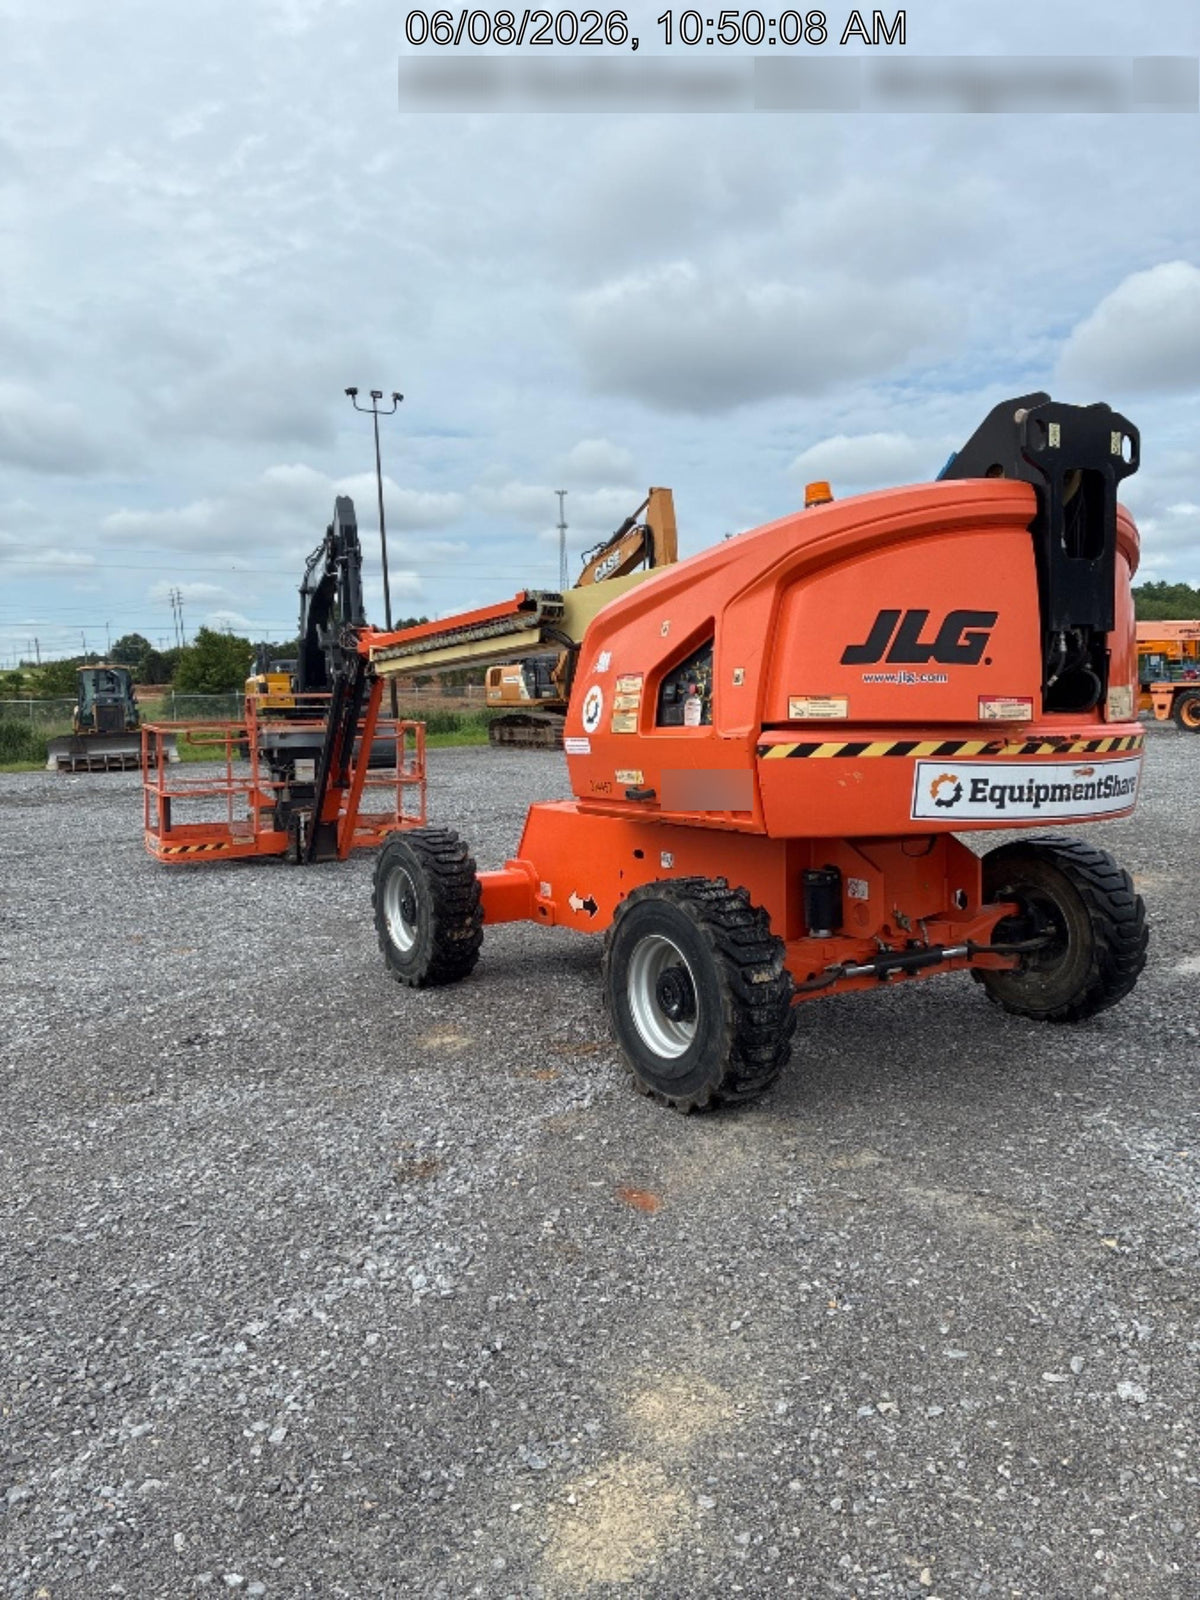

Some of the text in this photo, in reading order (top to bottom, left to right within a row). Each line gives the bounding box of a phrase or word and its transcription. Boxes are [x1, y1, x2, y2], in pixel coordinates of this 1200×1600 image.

[594, 549, 621, 583] CASE
[863, 671, 947, 684] www.jlg.com
[968, 774, 1136, 809] EquipmentShare
